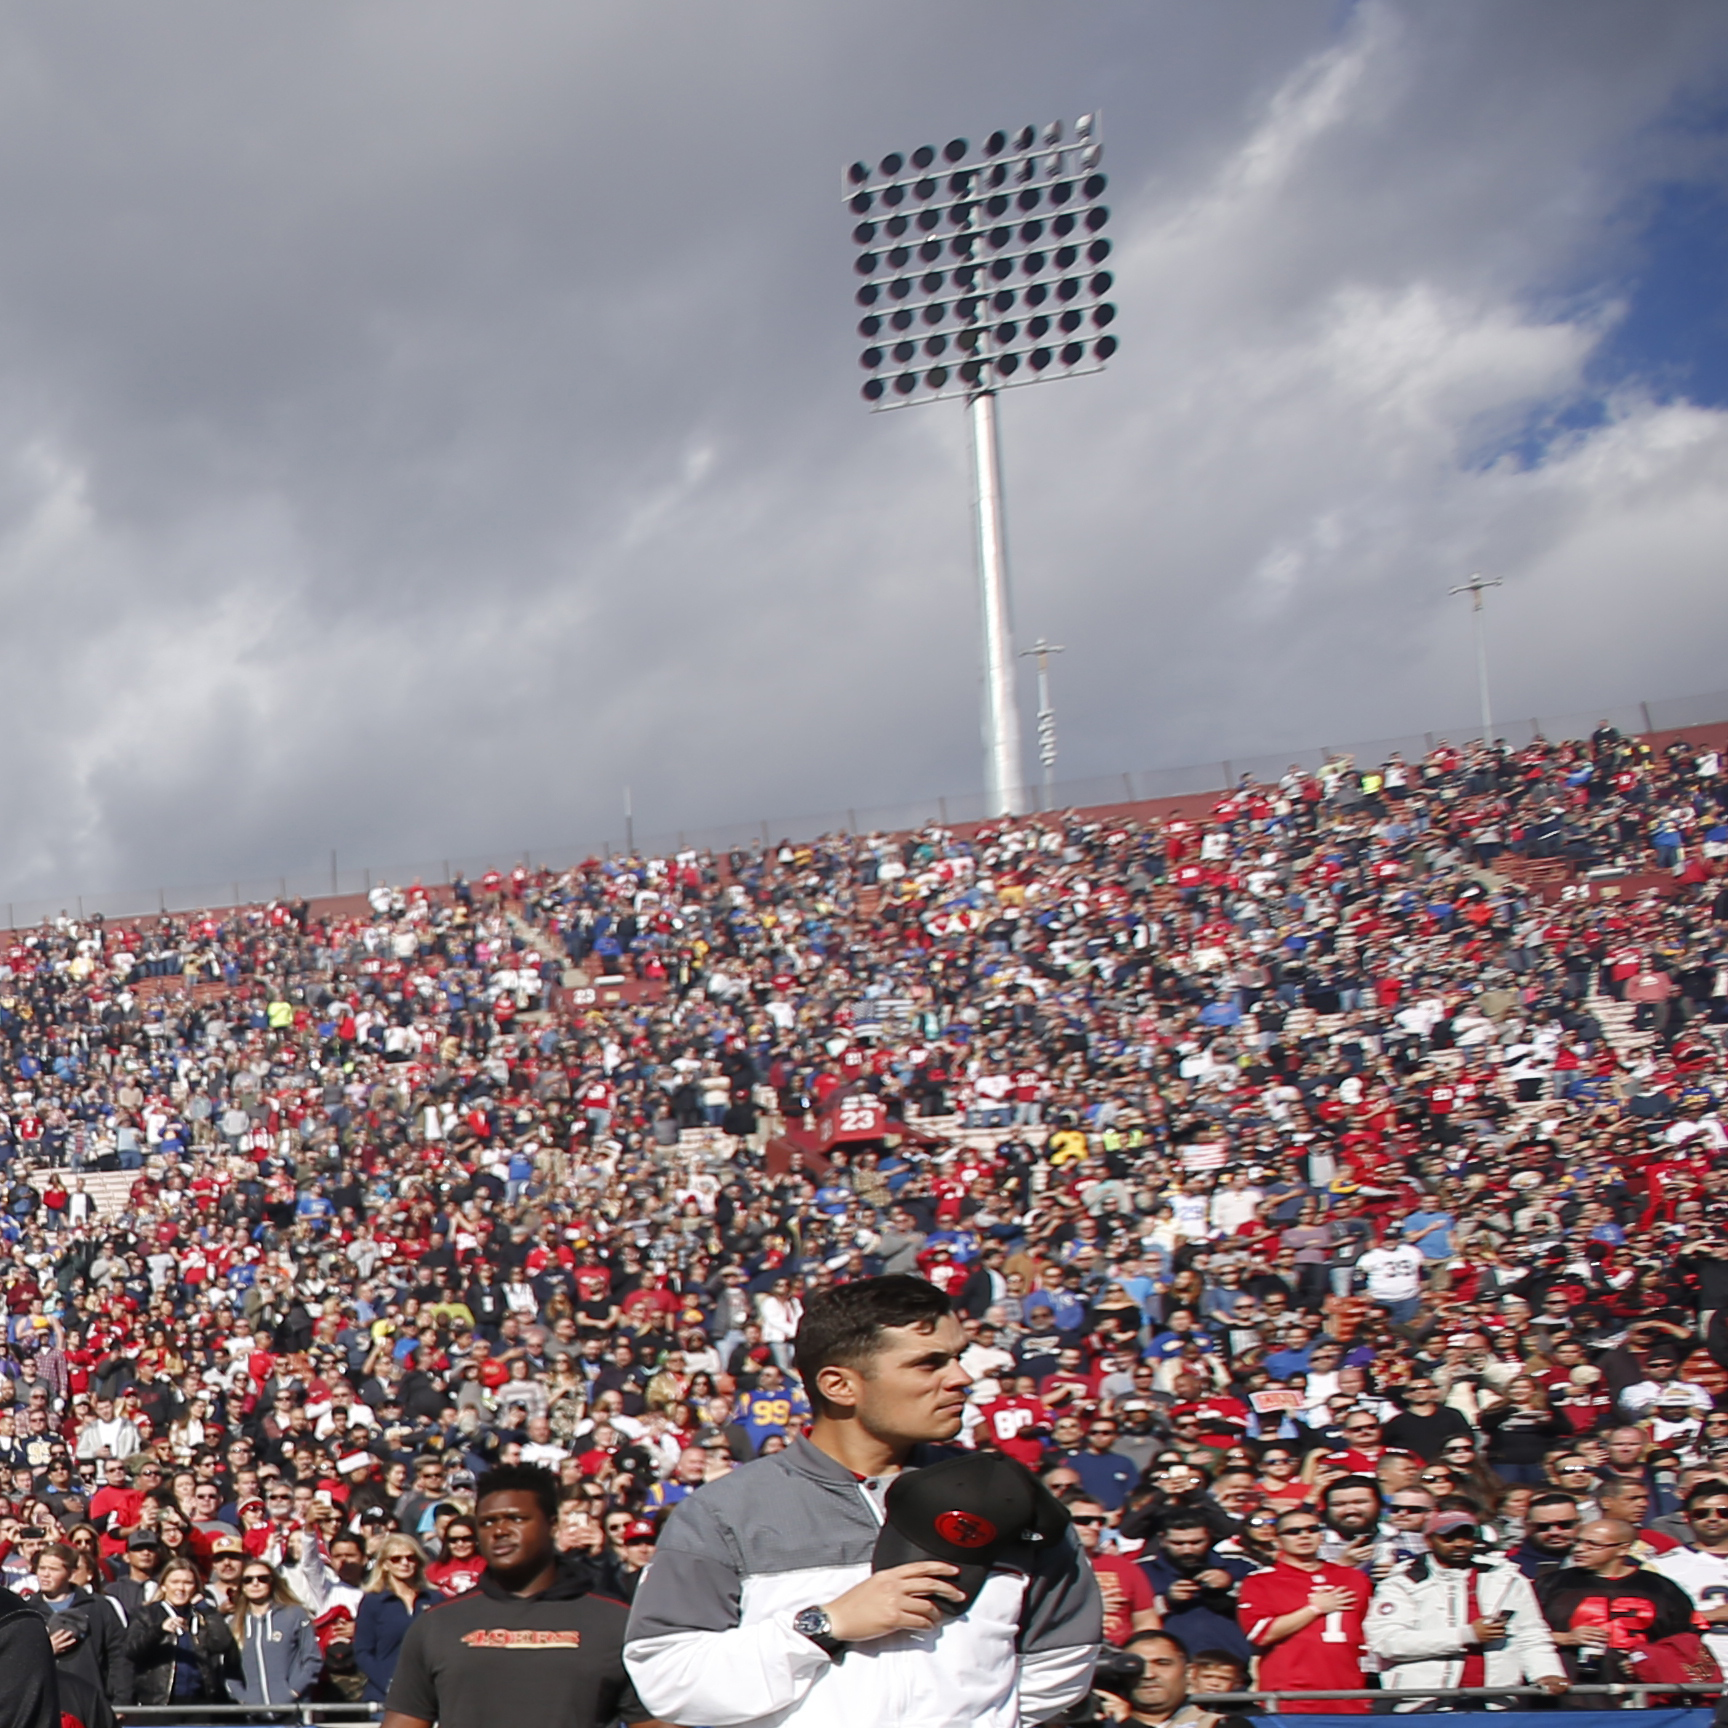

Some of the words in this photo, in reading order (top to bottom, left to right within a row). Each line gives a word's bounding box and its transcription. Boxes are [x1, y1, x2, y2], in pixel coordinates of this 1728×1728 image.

[840, 1108, 875, 1131] 23
[752, 1399, 791, 1426] 99
[459, 1628, 581, 1648] 49ERS
